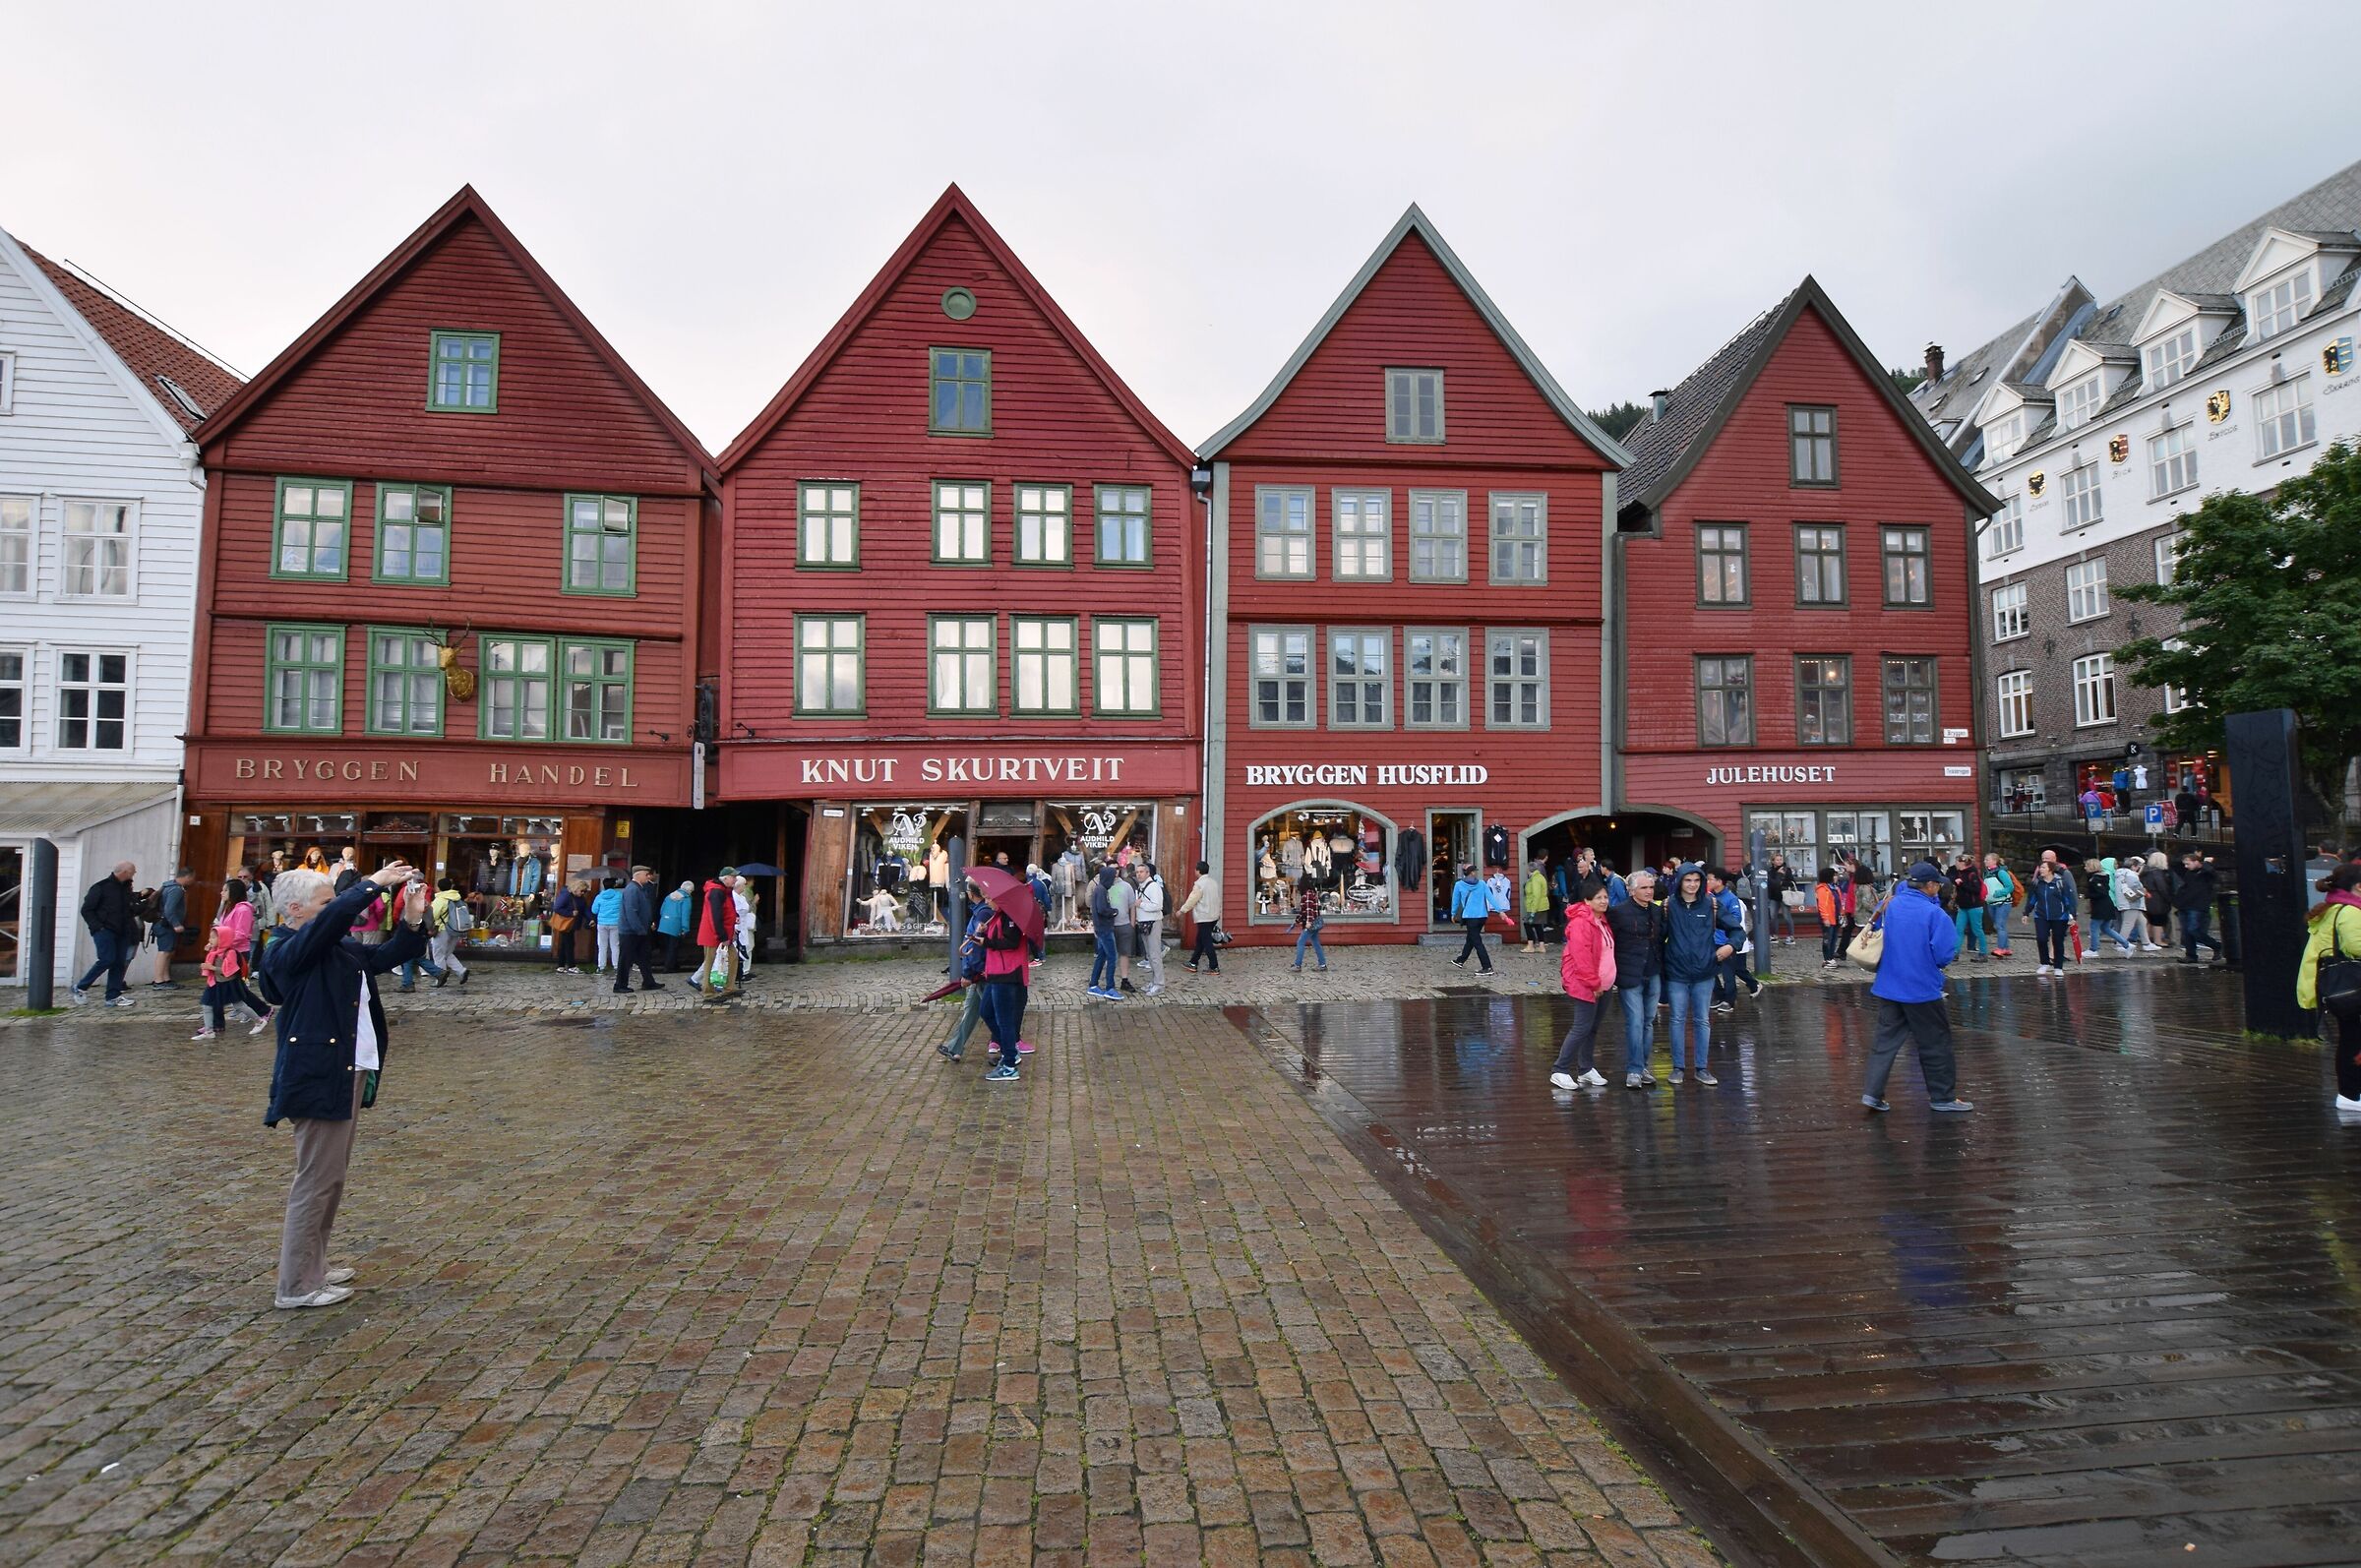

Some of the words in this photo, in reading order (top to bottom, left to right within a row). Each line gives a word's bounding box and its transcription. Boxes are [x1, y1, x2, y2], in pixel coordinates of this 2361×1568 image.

[235, 758, 420, 781] BRYGGEN
[489, 763, 639, 787] HANDEL
[801, 758, 898, 783] KNUT
[921, 757, 1124, 782] SKURTVEIT
[1245, 764, 1367, 785] BRYGGEN
[1377, 764, 1488, 785] HUSFLID
[1706, 766, 1836, 784] JULEHUSET
[2149, 808, 2158, 821] P
